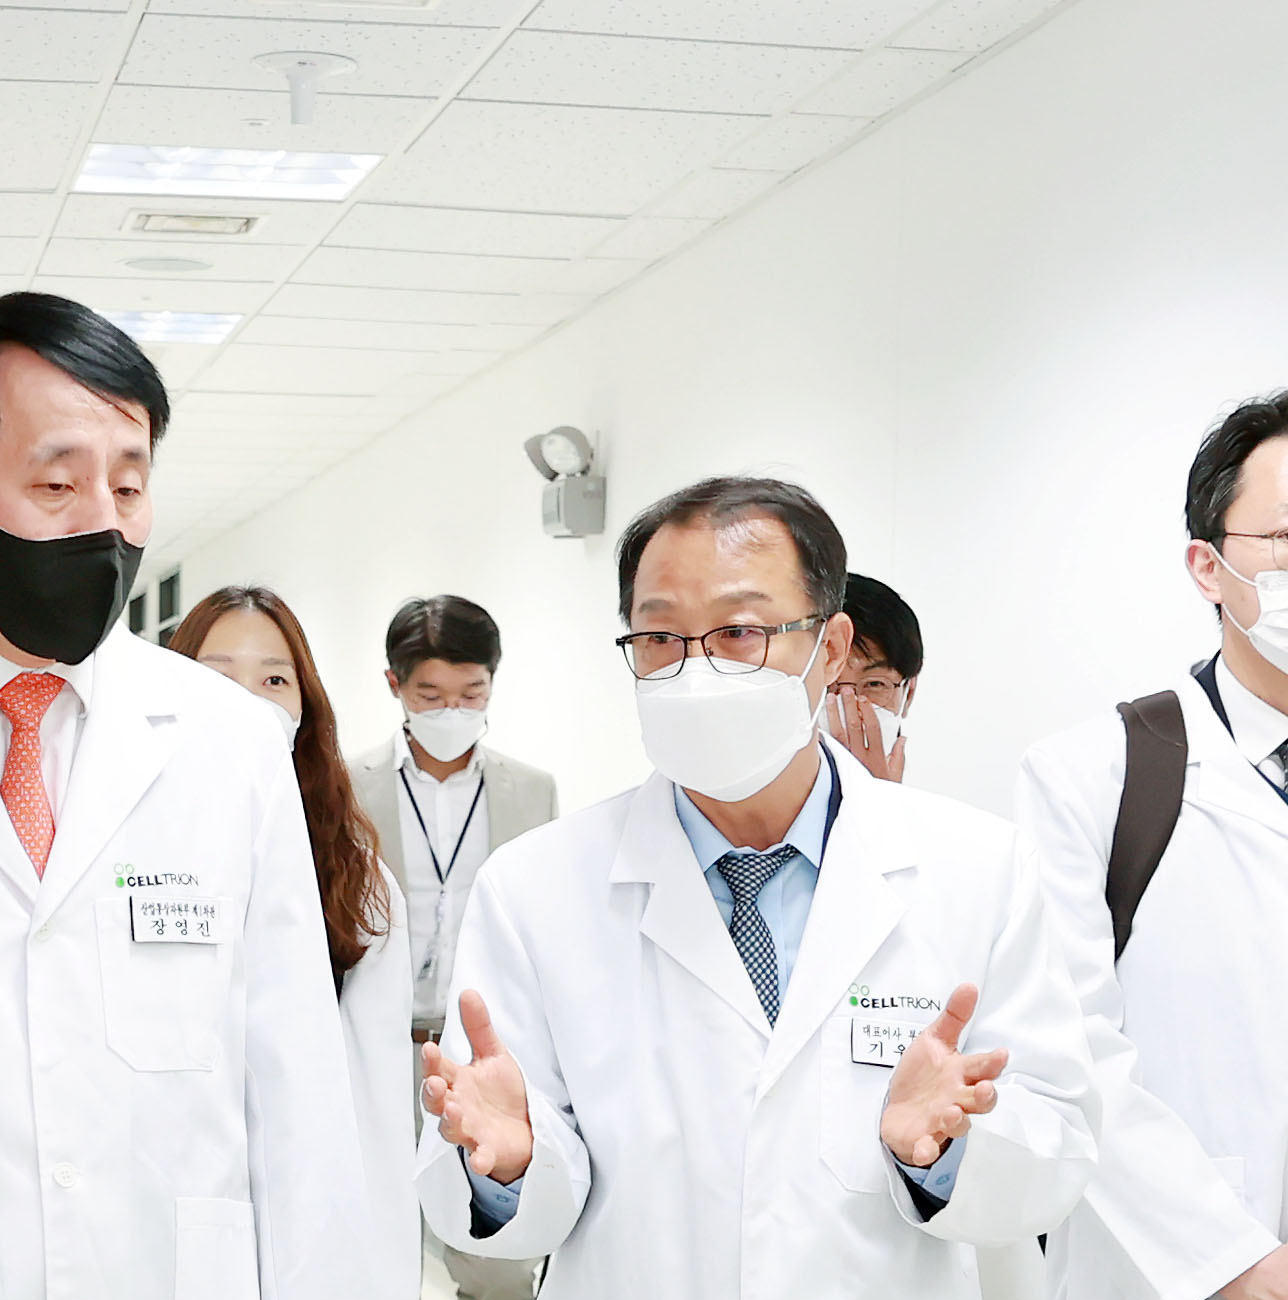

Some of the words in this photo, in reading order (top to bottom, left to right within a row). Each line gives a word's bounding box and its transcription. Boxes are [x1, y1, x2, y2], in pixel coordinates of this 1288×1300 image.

[127, 873, 200, 888] CELLTRION
[860, 996, 941, 1011] CELLTRION
[862, 1024, 902, 1041] 대표이사
